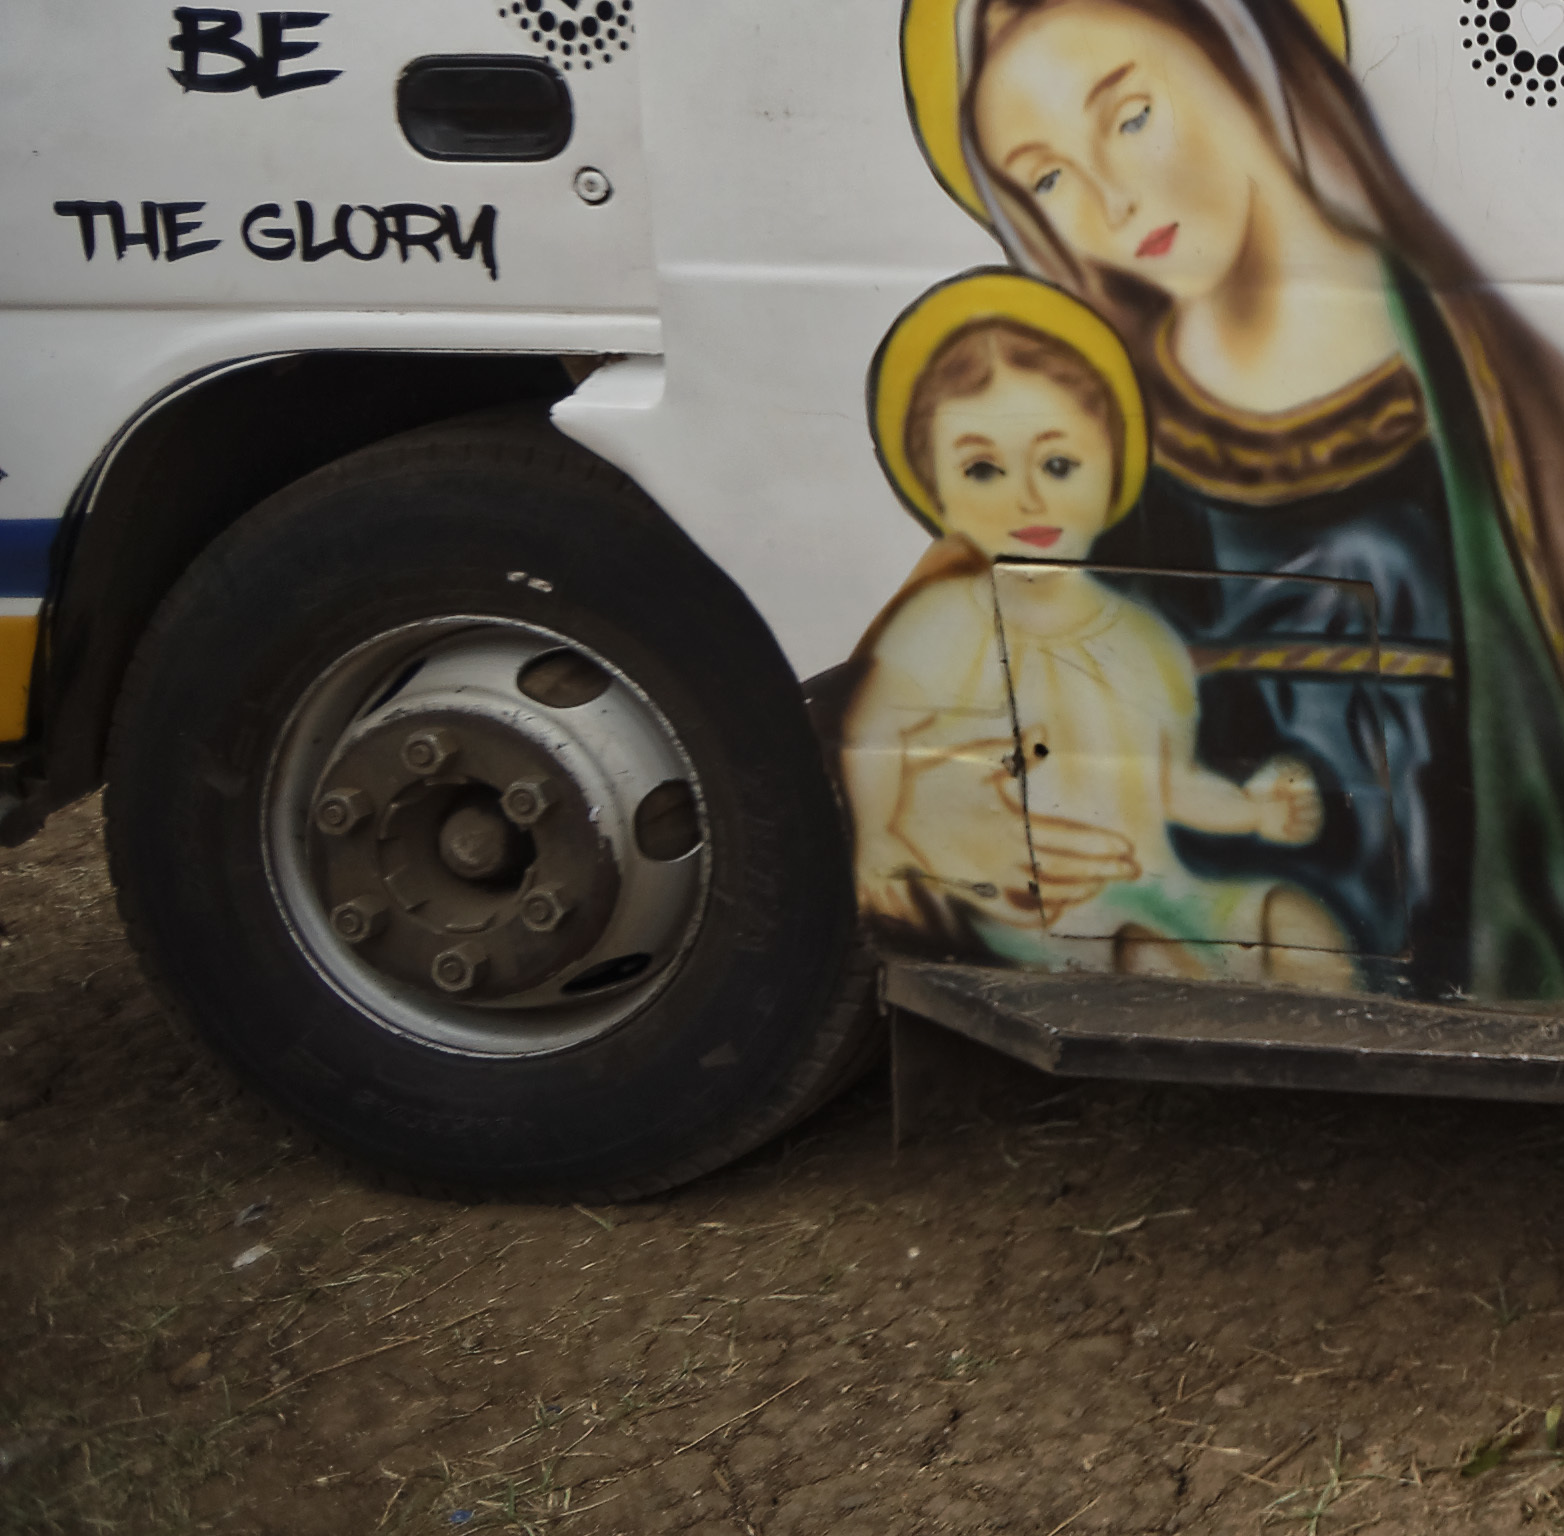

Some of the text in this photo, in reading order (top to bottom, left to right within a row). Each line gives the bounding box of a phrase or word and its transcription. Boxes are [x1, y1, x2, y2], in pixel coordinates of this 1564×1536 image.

[167, 5, 345, 99] BE
[53, 200, 499, 281] THE GLORY
